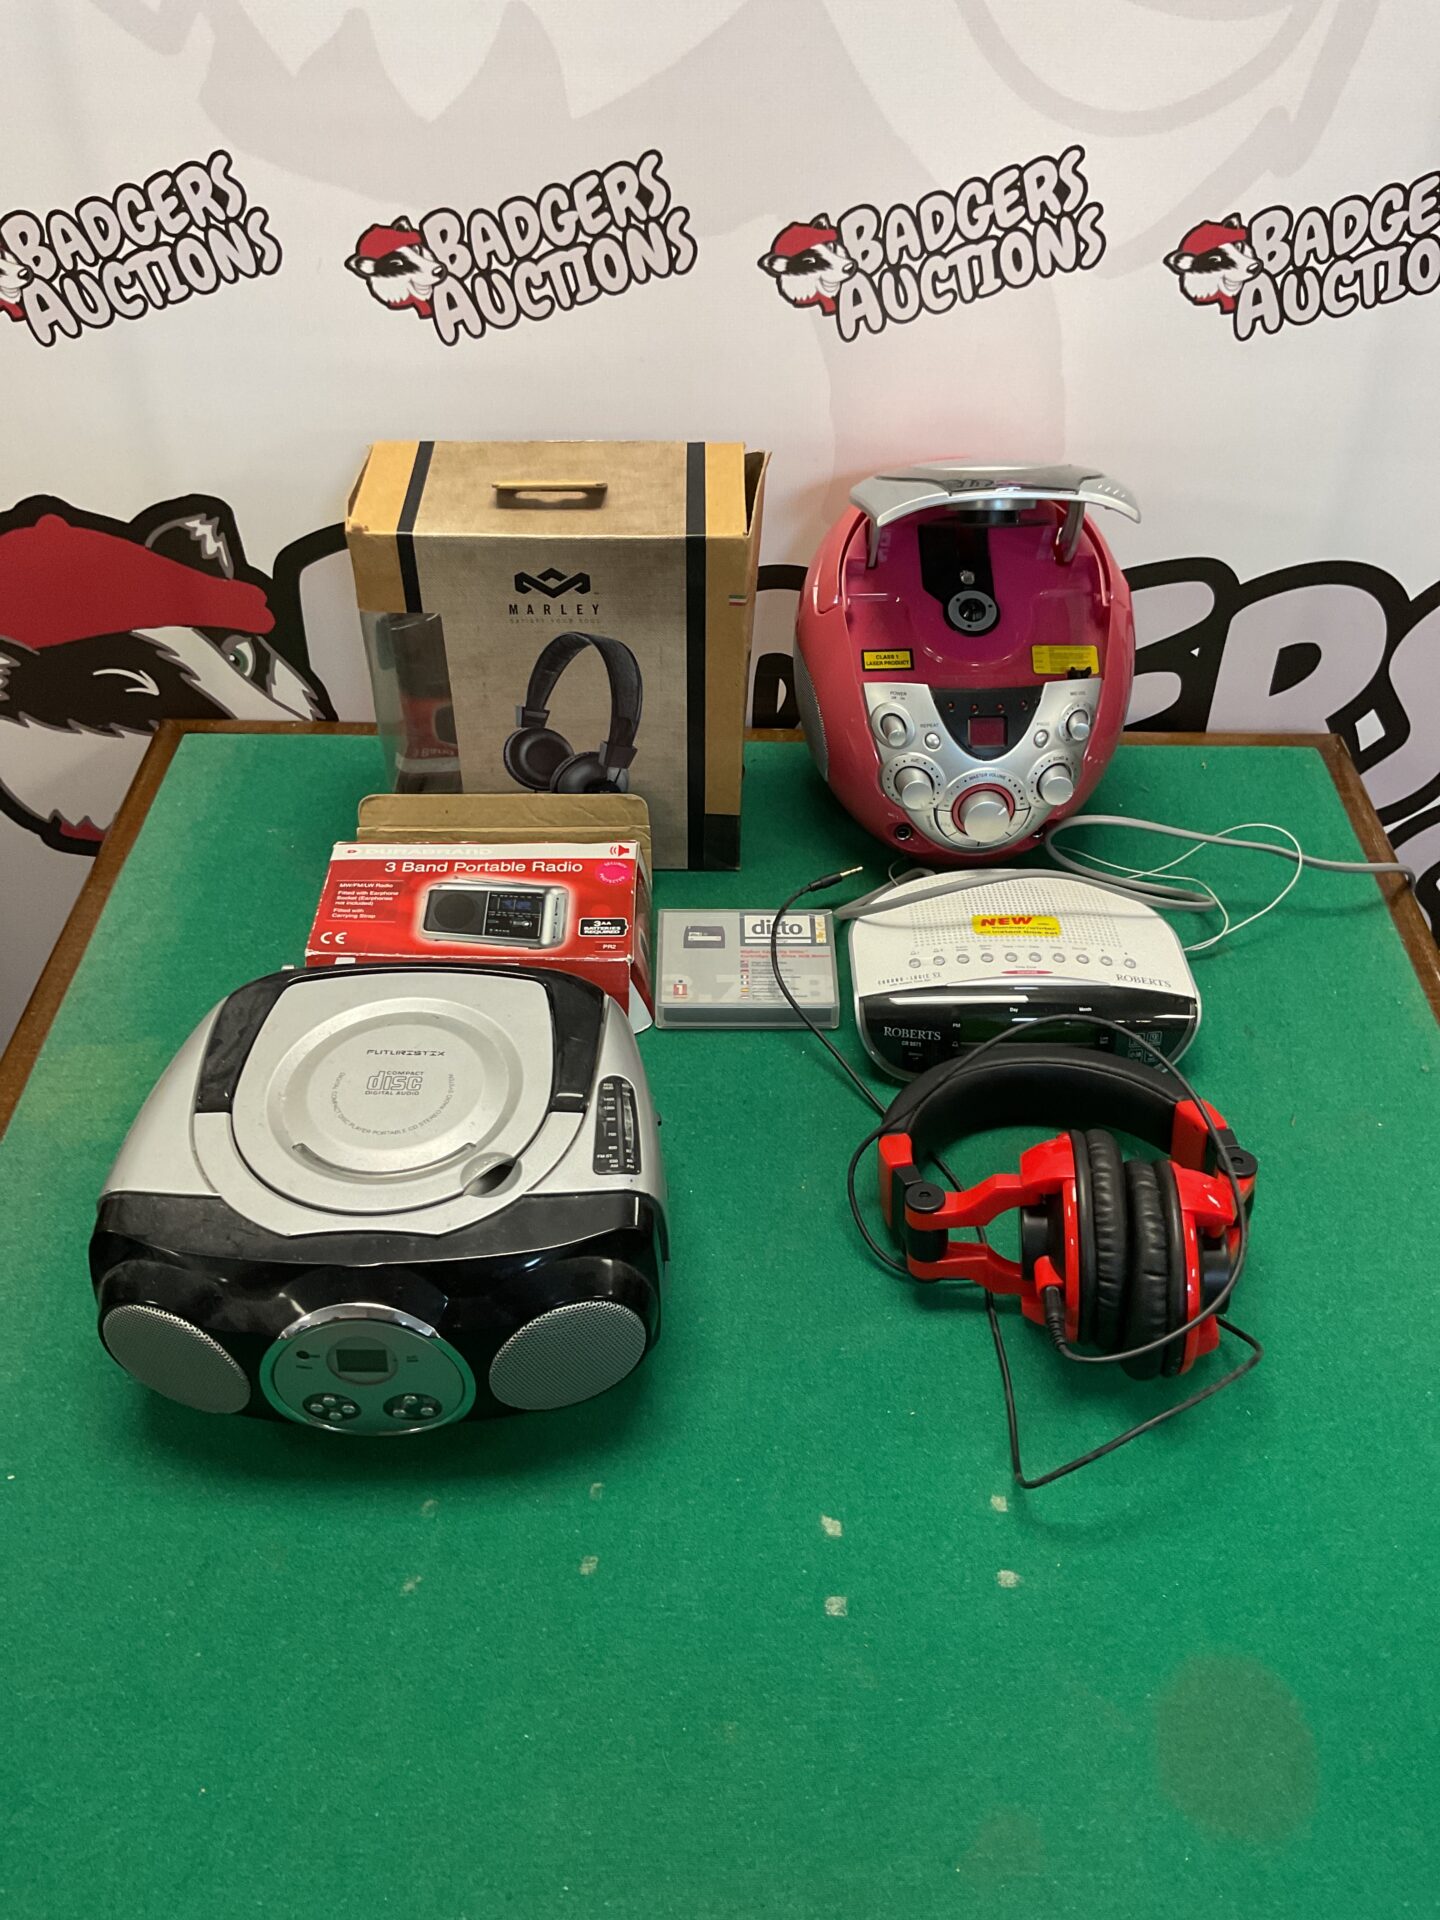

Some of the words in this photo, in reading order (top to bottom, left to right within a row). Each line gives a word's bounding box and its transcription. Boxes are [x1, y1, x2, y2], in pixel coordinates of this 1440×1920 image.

[0, 150, 246, 278] BADGERS
[419, 150, 671, 279] BADGERS
[837, 145, 1088, 275] BADGERS
[1248, 170, 1440, 277] BADGE
[21, 206, 282, 347] AUCTIONS
[432, 206, 698, 347] AUCTIONS
[835, 202, 1107, 342] AUCTIONS
[508, 603, 600, 615] MARLEY
[969, 772, 988, 780] MASTER
[384, 862, 396, 872] 3
[401, 862, 448, 872] Band
[454, 861, 526, 872] Portable
[532, 861, 583, 872] Radio
[980, 917, 1033, 927] NEW
[1116, 974, 1172, 988] ROBERTS
[883, 1026, 941, 1041] ROBERTS
[366, 1049, 445, 1057] FUTURISTIX
[366, 1070, 423, 1091] disc
[348, 1122, 372, 1134] PLAYER
[419, 1110, 441, 1127] STEREO
[440, 1094, 454, 1110] RADIO
